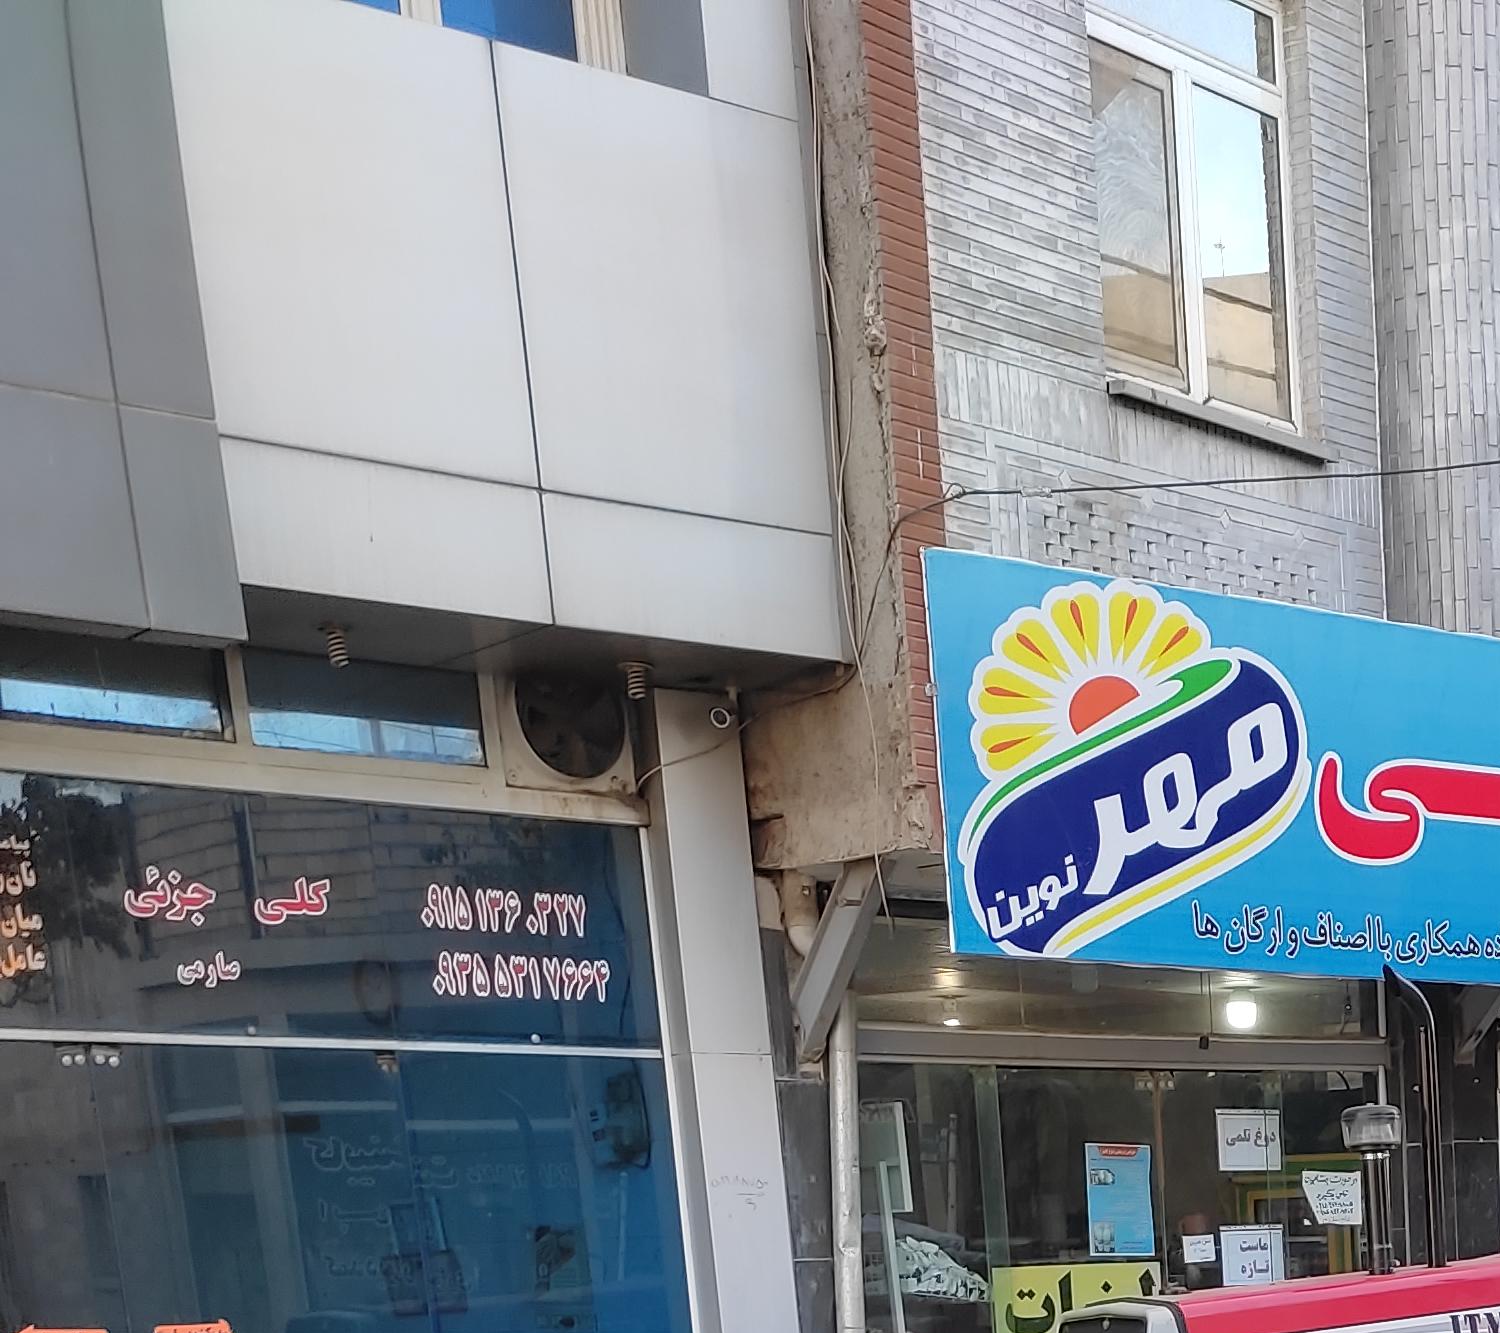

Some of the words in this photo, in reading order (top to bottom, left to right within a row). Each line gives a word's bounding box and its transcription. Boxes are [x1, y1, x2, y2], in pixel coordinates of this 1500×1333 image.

[1083, 702, 1288, 895] مهر
[254, 877, 330, 925] کلی
[987, 854, 1080, 938] نوین
[1288, 929, 1300, 958] و
[1303, 911, 1373, 953] اصناف
[1375, 915, 1391, 961] با
[1396, 918, 1479, 966] همکاری
[1239, 1237, 1269, 1252] ماست
[1241, 1259, 1270, 1278] تازه
